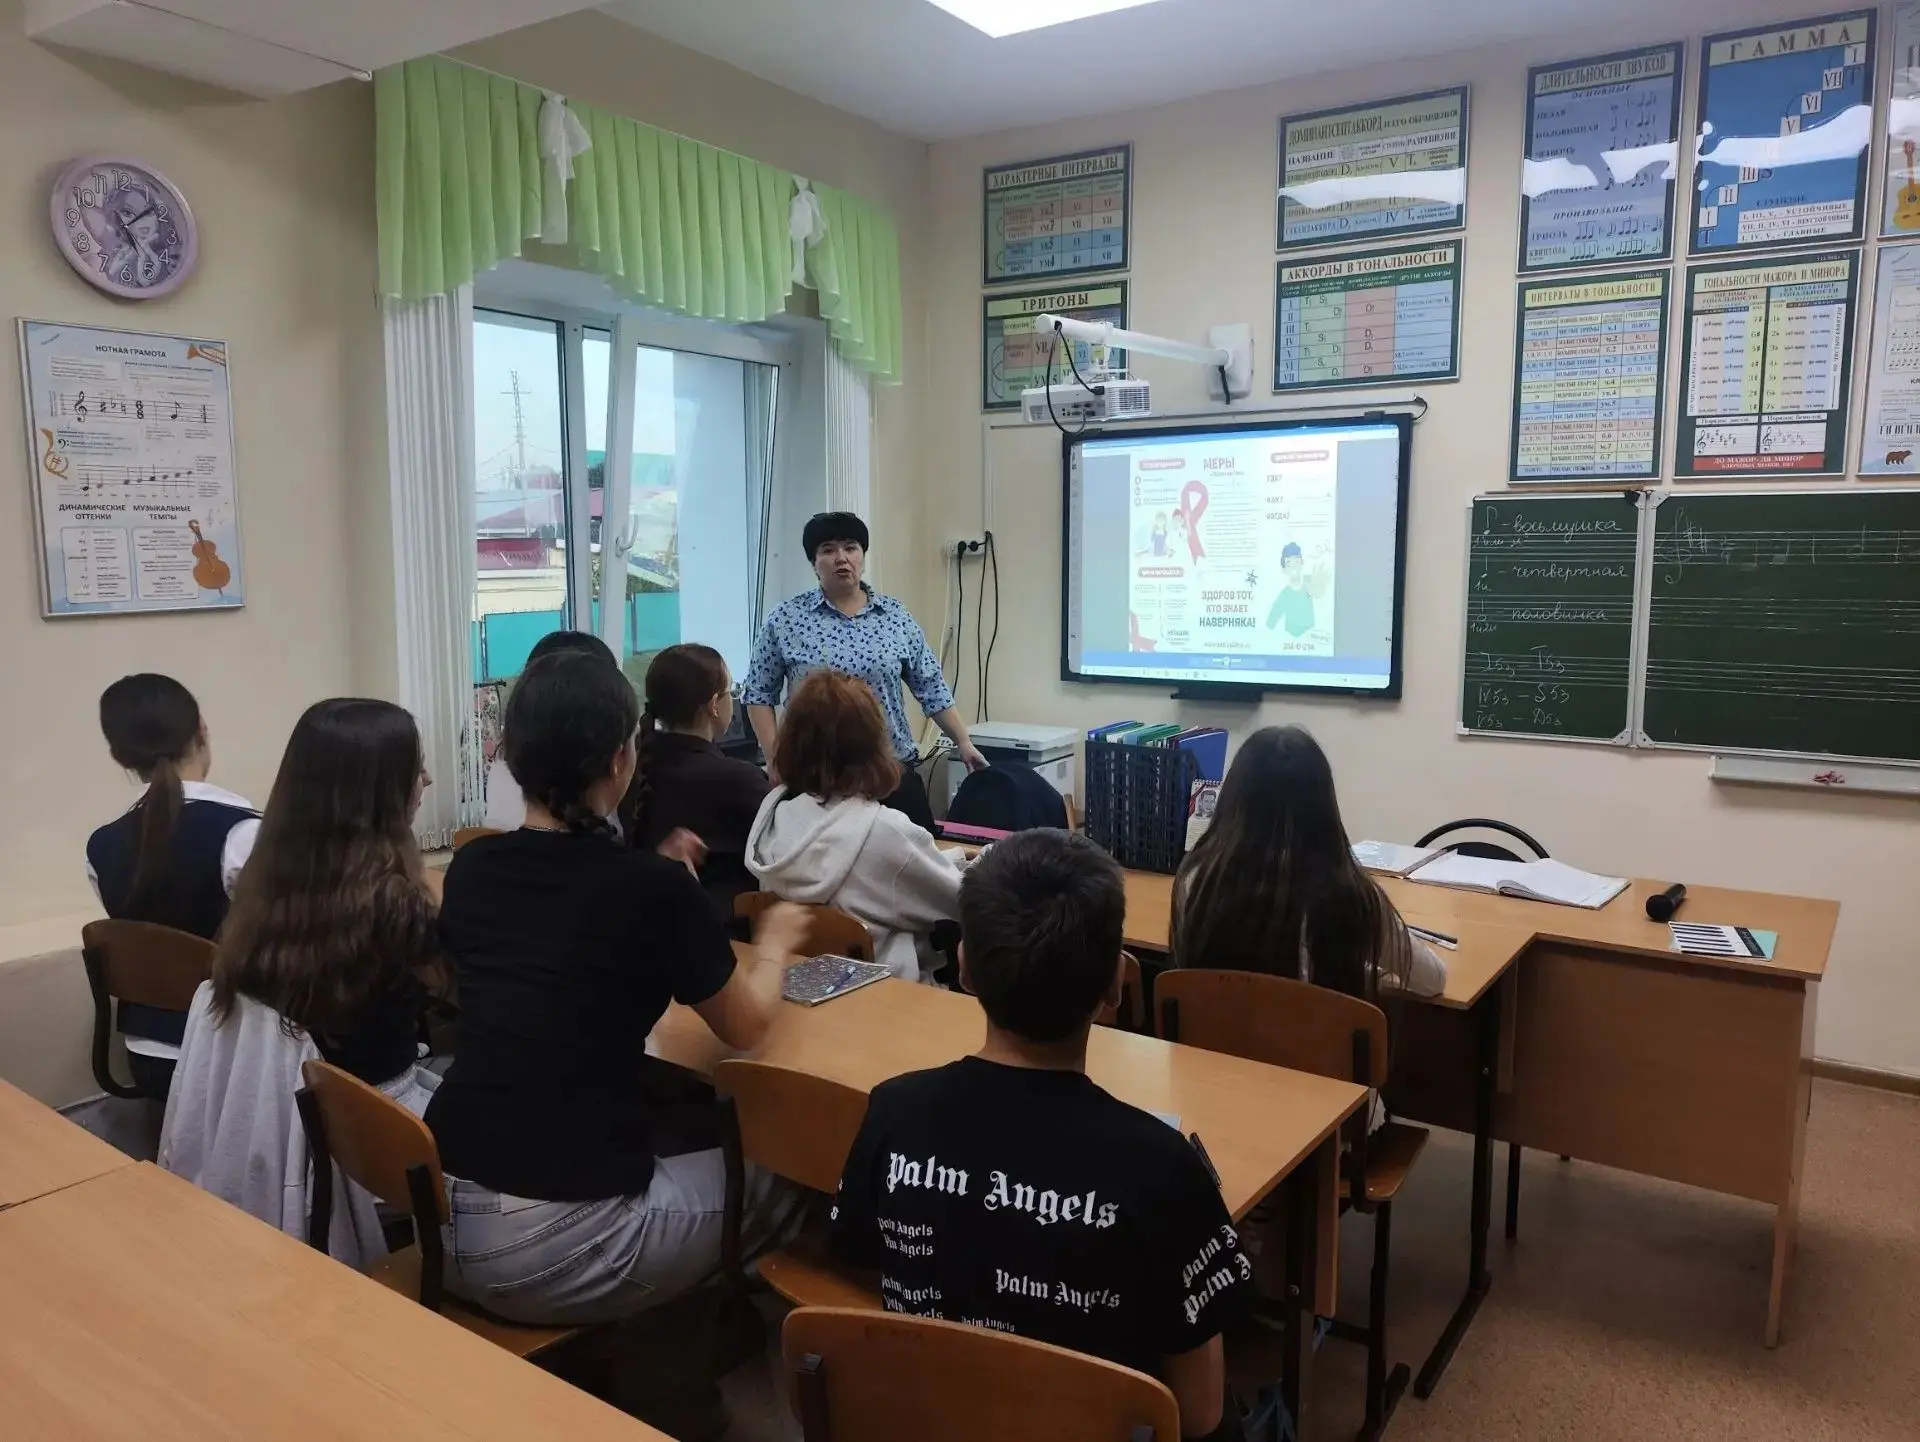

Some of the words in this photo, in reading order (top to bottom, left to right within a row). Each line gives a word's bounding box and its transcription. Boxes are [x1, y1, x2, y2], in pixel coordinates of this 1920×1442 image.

[1728, 25, 1852, 60] ГАММА
[1540, 64, 1622, 90] ДЛИТЕЛЬНОСТИ
[1626, 55, 1667, 77] ЗВУКОВ
[1824, 71, 1844, 89] VII
[1805, 95, 1820, 112] VI
[1288, 116, 1383, 147] ДОМИНАНТСЕПТАККОРД
[1786, 119, 1797, 135] V
[1406, 131, 1457, 147] РАЗРЕШЕНИЕ
[1288, 151, 1335, 165] НАЗВАНИЕ
[993, 166, 1057, 187] ХАРАКТЕРНЫЕ
[1062, 155, 1118, 178] ИНТЕРВАЛЫ
[93, 173, 107, 195] 11
[112, 169, 132, 192] 12
[73, 186, 95, 208] 10
[144, 185, 150, 202] 1
[1724, 188, 1733, 204] II
[66, 208, 80, 227] 9
[158, 204, 168, 223] 2
[1386, 211, 1400, 224] IV
[1553, 204, 1633, 220] ПРОИЗВОЛЬНЫЕ
[166, 228, 177, 245] 3
[1783, 227, 1827, 239] ГЛАВНЫЕ
[77, 233, 90, 252] 8
[98, 252, 109, 272] 7
[158, 248, 170, 264] 4
[120, 264, 133, 282] 6
[143, 262, 155, 279] 5
[1287, 264, 1342, 281] АККОРДЫ
[1347, 262, 1354, 273] В
[1356, 250, 1448, 273] ТОНАЛЬНОСТИ
[1703, 273, 1760, 289] ТОНАЛЬНОСТИ
[1763, 270, 1797, 284] МАЖОРА
[1800, 270, 1807, 279] И
[1809, 266, 1846, 280] МИНОРА
[1531, 289, 1581, 303] ИНТЕРВАЛЫ
[1592, 281, 1656, 298] ТОНАЛЬНОСТИ
[1021, 293, 1089, 311] ТРИТОНЫ
[95, 345, 129, 355] НОТНАЯ
[130, 347, 167, 358] ГРАМОТА
[58, 503, 126, 512] ДИНАМИЧЕСКИЕ
[133, 504, 191, 513] МУЗЫКАЛЬНЫЕ
[149, 513, 177, 521] ТЕМПЫ
[1513, 513, 1623, 543] восьмушка
[1511, 562, 1629, 583] четвертная
[1201, 590, 1235, 601] ЗДОРОВ
[1206, 604, 1222, 613] КТО
[1222, 604, 1249, 613] ЗНАЕТ
[1511, 601, 1608, 621] половинка
[1199, 616, 1256, 628] НАВЕРНЯКА!
[887, 1152, 970, 1194] Palm
[983, 1170, 1121, 1230] Angels
[897, 1220, 934, 1239] Angels
[1182, 1237, 1222, 1289] Palm
[995, 1268, 1049, 1300] Palm
[1054, 1280, 1121, 1313] Angels
[1183, 1267, 1236, 1325] Palm
